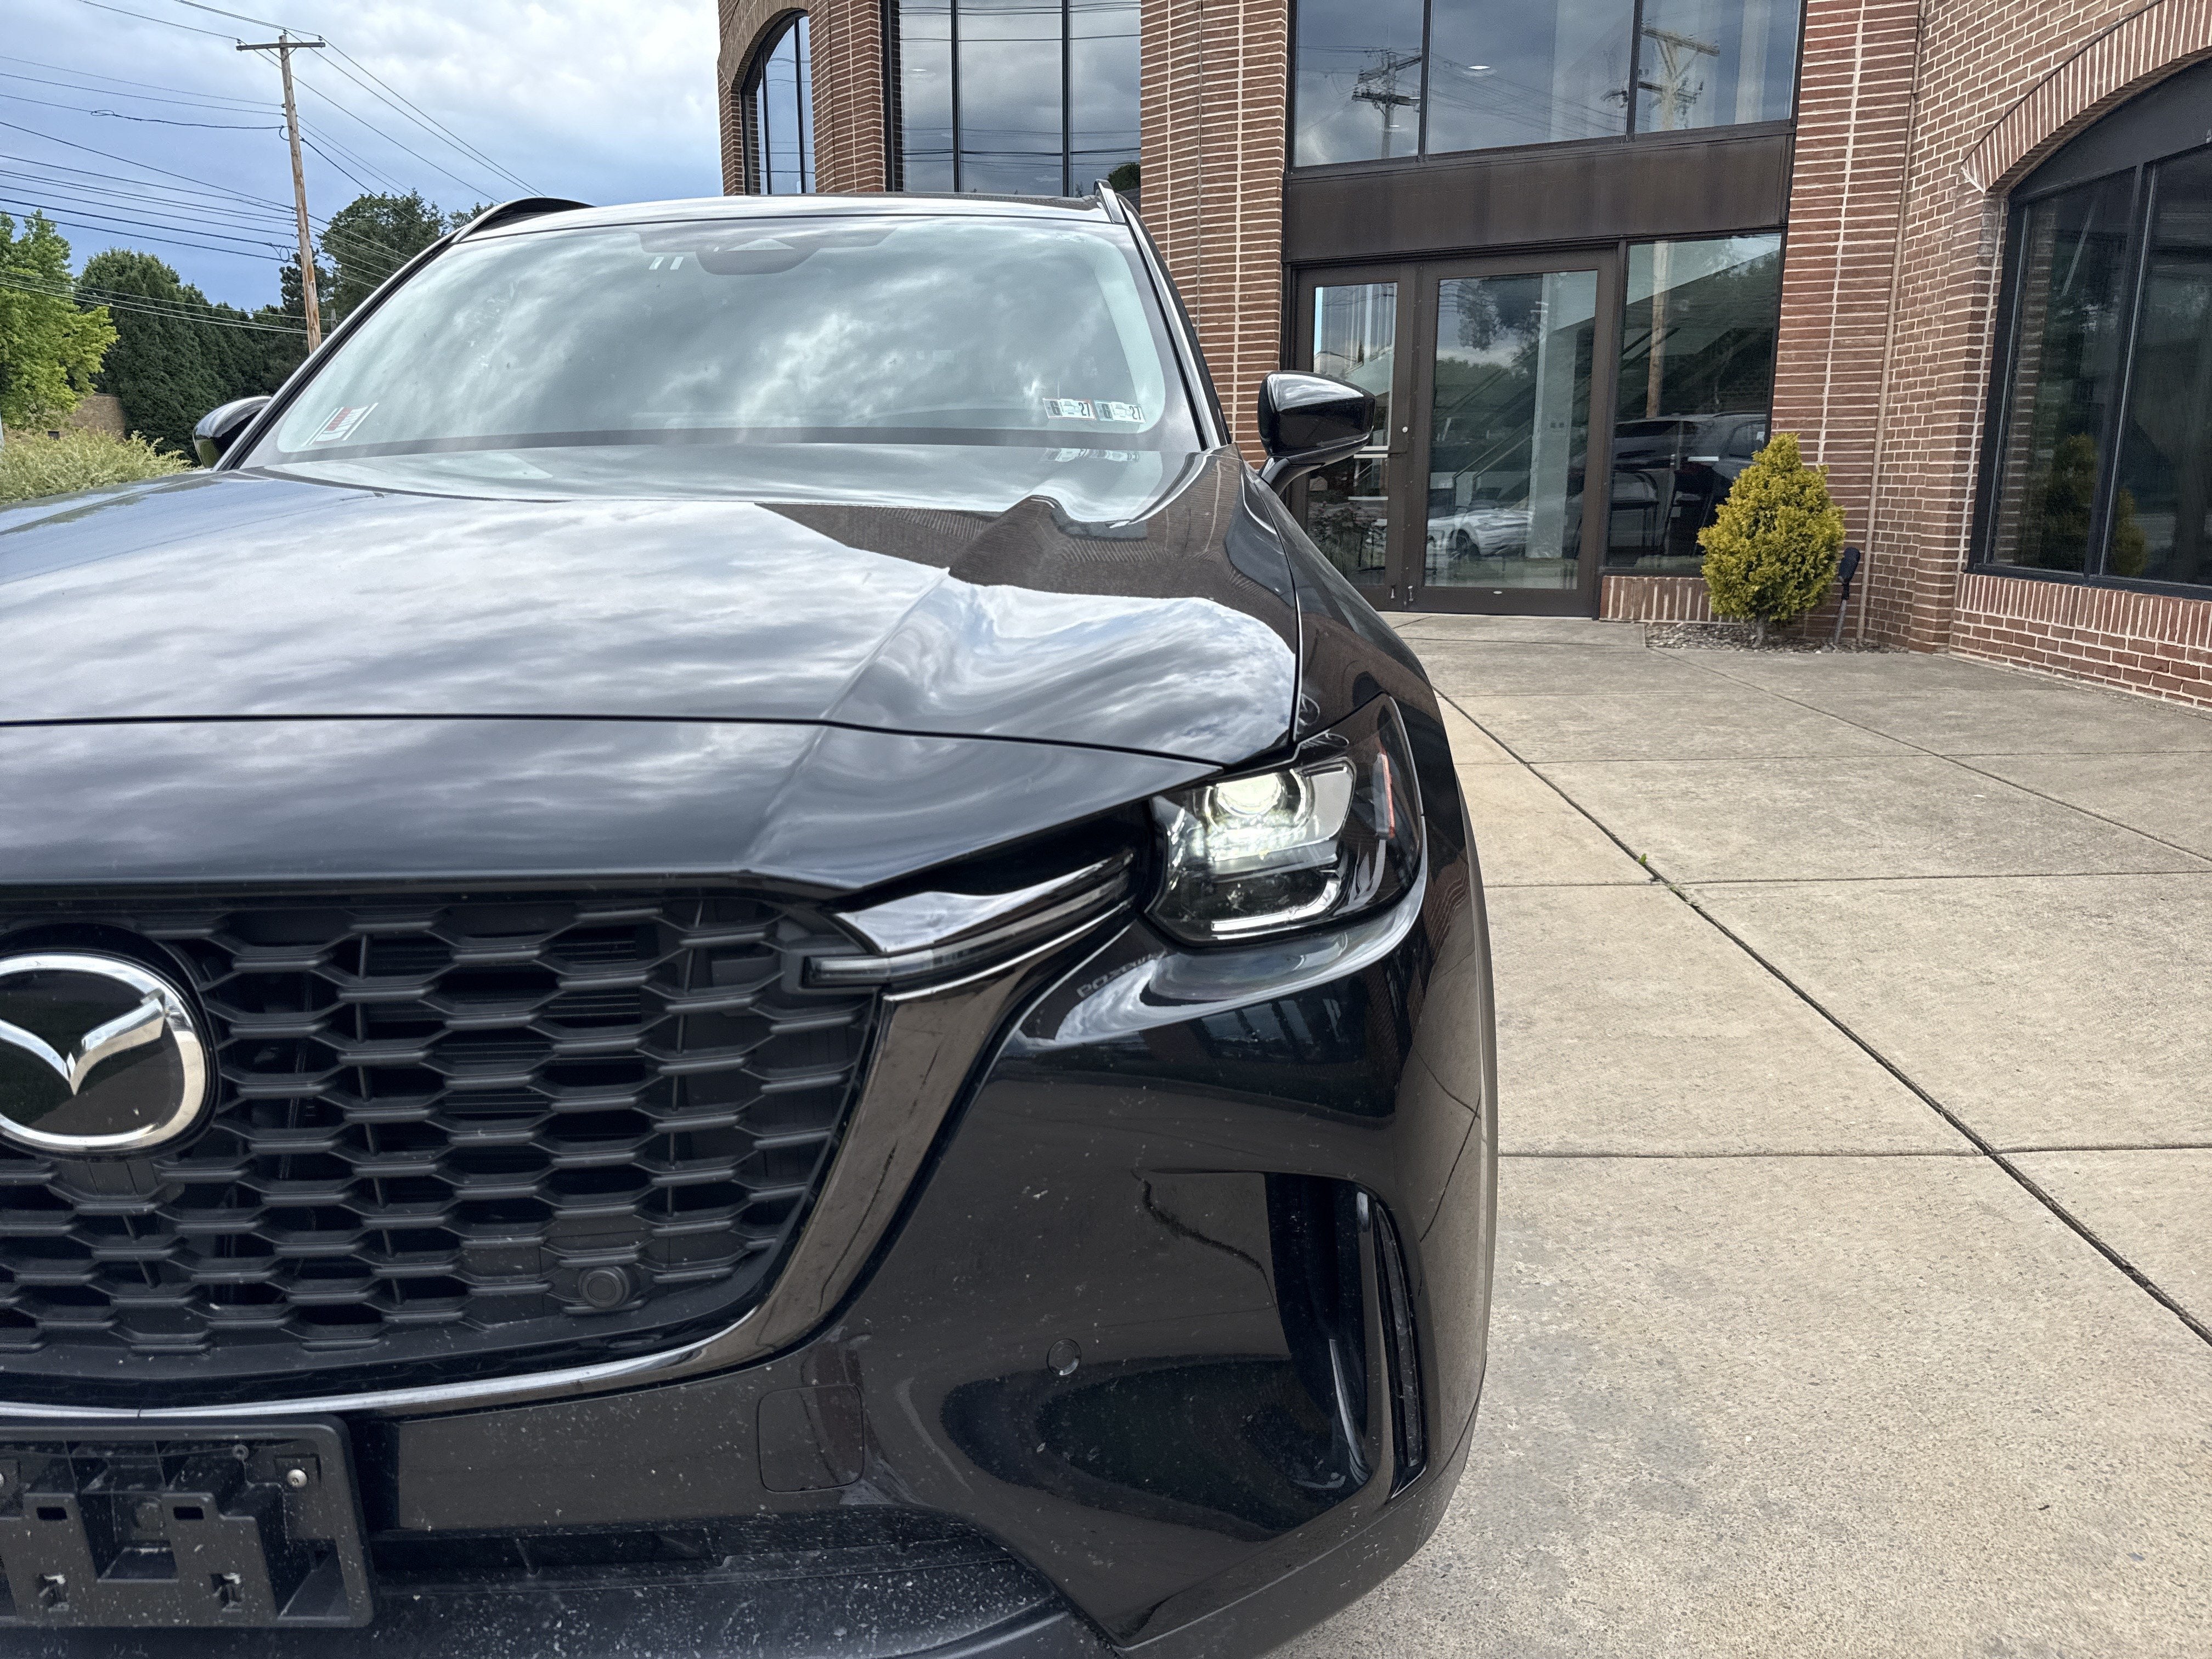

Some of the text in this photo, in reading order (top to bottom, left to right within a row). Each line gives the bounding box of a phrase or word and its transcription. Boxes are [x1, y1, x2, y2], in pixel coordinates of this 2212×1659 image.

[1049, 400, 1091, 417] 6 27
[1128, 406, 1142, 420] 27
